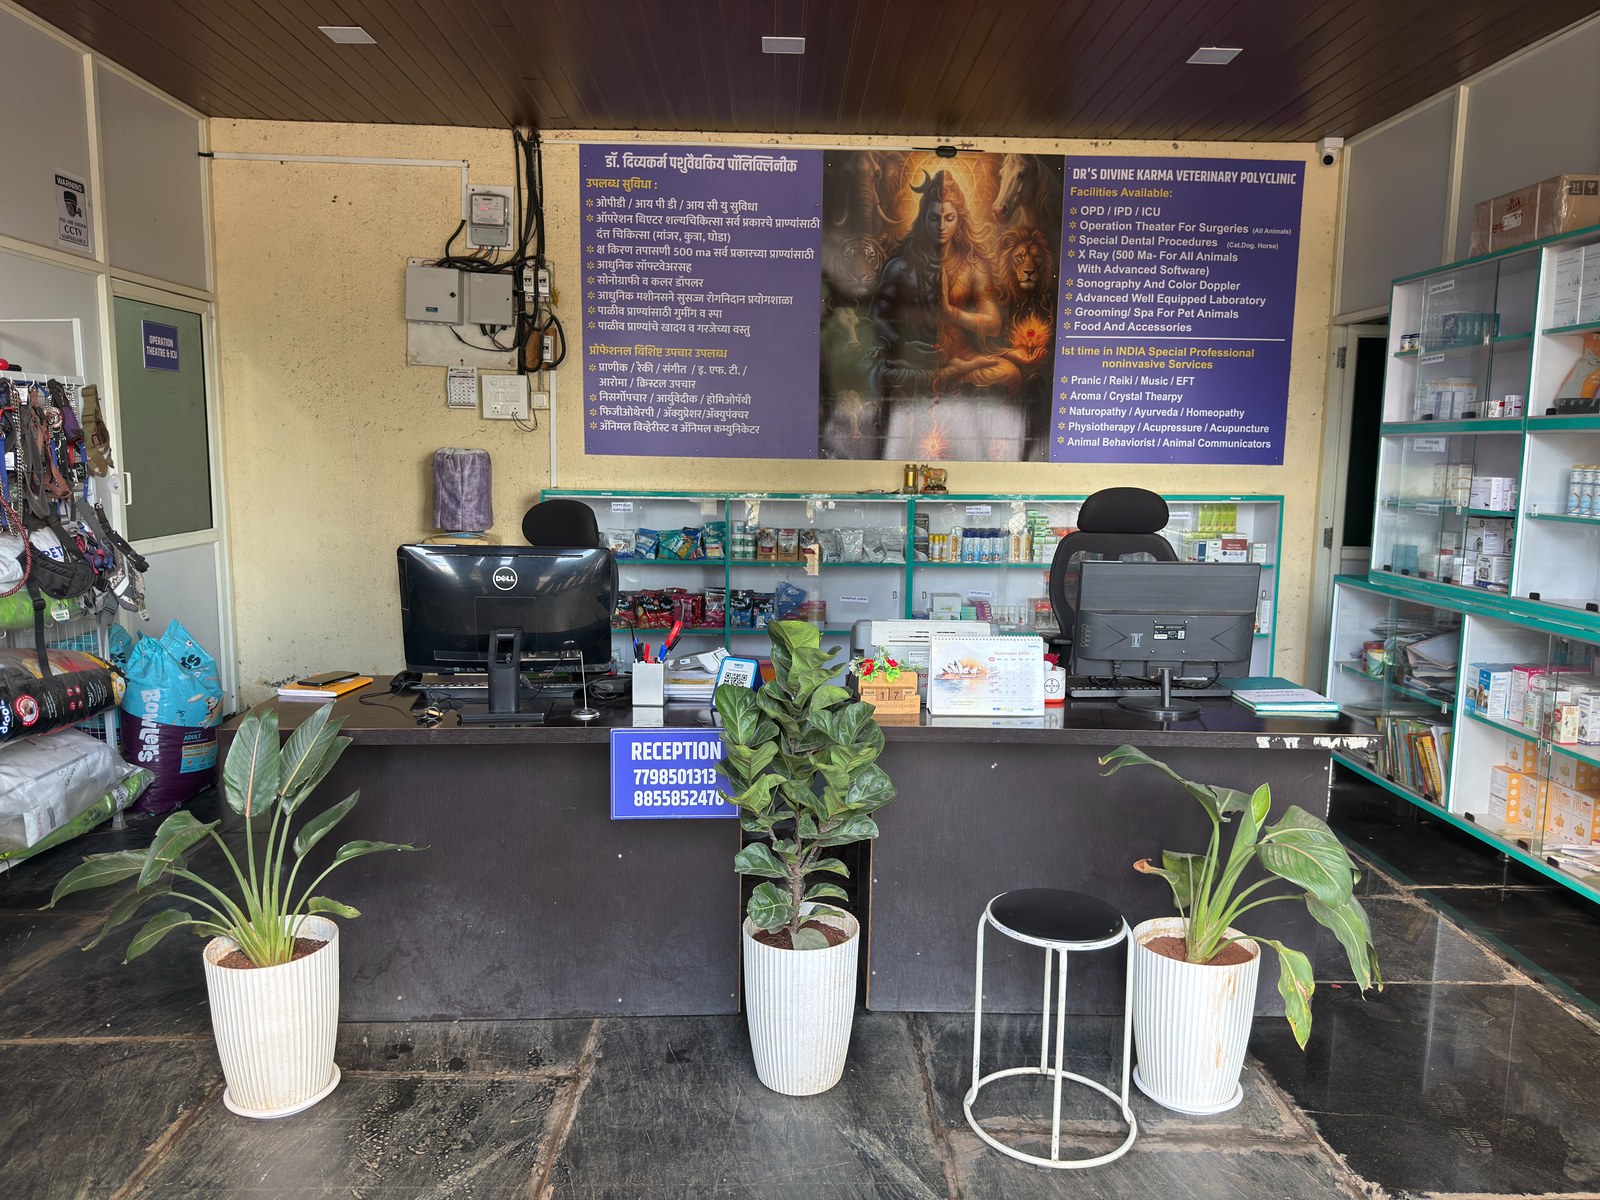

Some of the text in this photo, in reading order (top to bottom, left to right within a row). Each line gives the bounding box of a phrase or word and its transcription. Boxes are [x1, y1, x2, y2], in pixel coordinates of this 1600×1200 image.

[605, 152, 620, 168] डॉ.
[622, 152, 667, 169] दिव्यकर्म
[727, 155, 798, 172] पॉलिक्लिनीक
[1073, 167, 1296, 184] DR'S DIVINE KARMA VETERINARY POLYCLINIC
[56, 176, 83, 192] WARNING
[586, 176, 652, 192] उपलब्ध सुविधा
[1070, 187, 1173, 198] Facilities Available:
[596, 196, 758, 214] ओपीडी आय डी आय सी सुविधा
[1081, 206, 1161, 216] OPD IPD ICU
[596, 211, 820, 228] ऑपरेशन थिएटर शल्यचिकित्सा सर्व प्रकारचे प्राण्यांसाठी
[64, 224, 82, 236] CCTV
[1080, 221, 1249, 234] Operation Theater For Surgeries
[613, 228, 731, 244] चिकित्सा (मांजर, कुत्रा, घोडा)
[1079, 235, 1118, 246] Special
[1121, 236, 1154, 245] Dental
[1158, 236, 1218, 247] Procedures
[607, 243, 633, 255] किरण
[635, 244, 671, 256] तपासणी
[673, 247, 692, 256] 500
[714, 246, 728, 257] सर्व
[730, 248, 767, 258] प्रकारच्या
[770, 248, 814, 260] प्राण्यांसाठी
[1078, 250, 1238, 262] X Ray (500 For All Animals
[597, 259, 692, 273] आधुनिक सॉफ्टवेअरसह
[1077, 264, 1210, 277] With Advanced Software)
[597, 273, 704, 288] सोनोग्राफी कलर डॉपलर
[1077, 279, 1241, 292] Sonography And Color Doppler
[598, 289, 793, 305] आधुनिक मशीनसने सुसज्ज रोगनिदान प्रयोगशाळा
[1076, 293, 1266, 306] Advanced Well Equipped Laboratory
[598, 304, 722, 318] पाळीव प्राण्यांसाठी स्पा
[1075, 307, 1239, 320] Grooming/ Spa For Pet Animals
[598, 319, 751, 337] पाळीव प्राण्यांचे गरजेच्या वस्तु
[1074, 322, 1192, 332] Food And Accessories
[149, 335, 173, 348] OPERATION
[146, 346, 166, 357] THEATRE
[589, 344, 632, 356] प्रोफेशनल
[665, 348, 693, 357] उपचार
[695, 349, 728, 358] उपलब्ध
[1077, 346, 1255, 358] time in INDIA Special Professional
[599, 361, 727, 375] प्राणीक रेकी संगीत एफ.
[1102, 360, 1213, 370] noninvasive Services
[599, 375, 696, 388] आरोमा क्रिस्टल उपचार
[1071, 376, 1195, 386] Pranic Reiki Music EFT
[599, 390, 647, 402] निसर्गोपचार
[1070, 392, 1183, 403] Aroma Crystal Thearpy
[599, 405, 654, 417] फिजीओथेरपी
[1070, 407, 1245, 419] Naturopathy Ayurveda Homeopathy
[713, 423, 760, 436] कम्युनिकेटर
[1068, 422, 1270, 435] Physiotherapy Acupressure Acupuncture
[1067, 438, 1271, 449] Animal Behaviorist Animal Communicators
[881, 692, 884, 700] 1
[631, 741, 722, 760] RECEPTION
[633, 769, 717, 785] 7798501313
[633, 790, 725, 806] 8855852476
